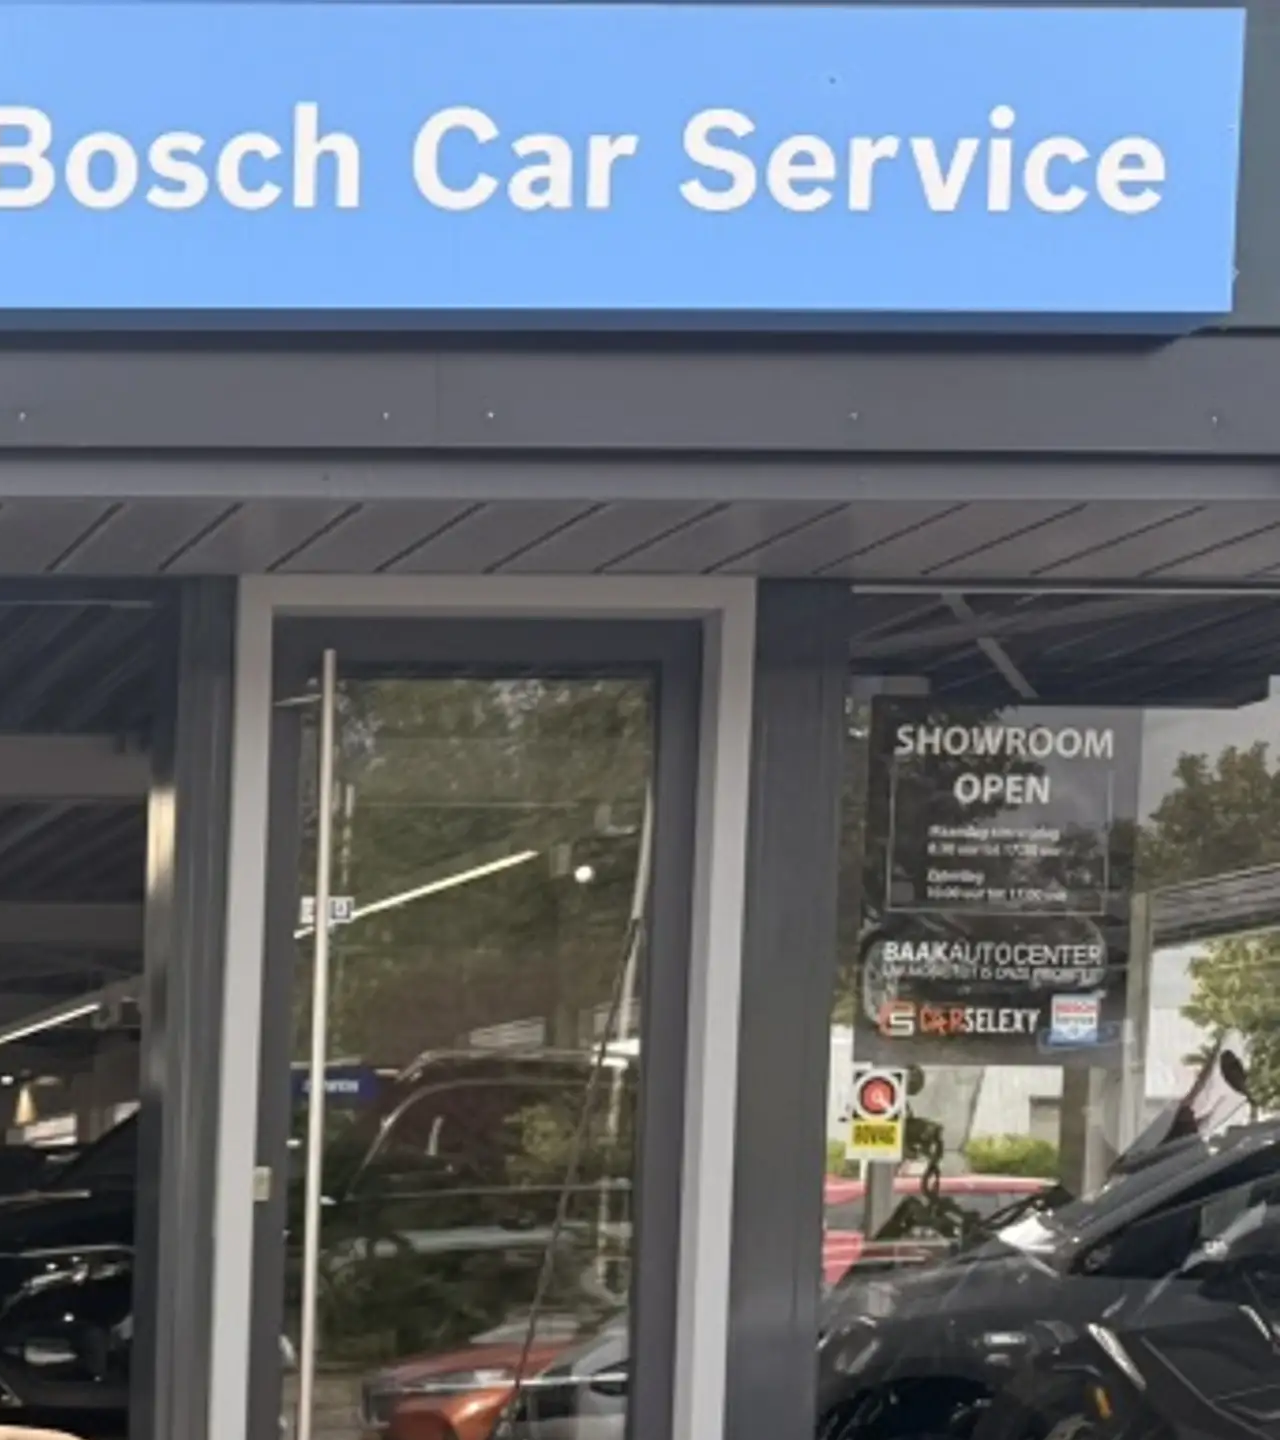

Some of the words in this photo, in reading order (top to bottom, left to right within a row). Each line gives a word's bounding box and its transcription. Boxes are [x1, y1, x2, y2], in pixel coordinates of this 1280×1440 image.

[412, 106, 639, 212] Car
[679, 106, 1168, 214] Service
[894, 726, 1114, 758] SHOWROOM
[953, 773, 1050, 805] OPEN
[883, 940, 1103, 966] BAAKAUTOCENTER
